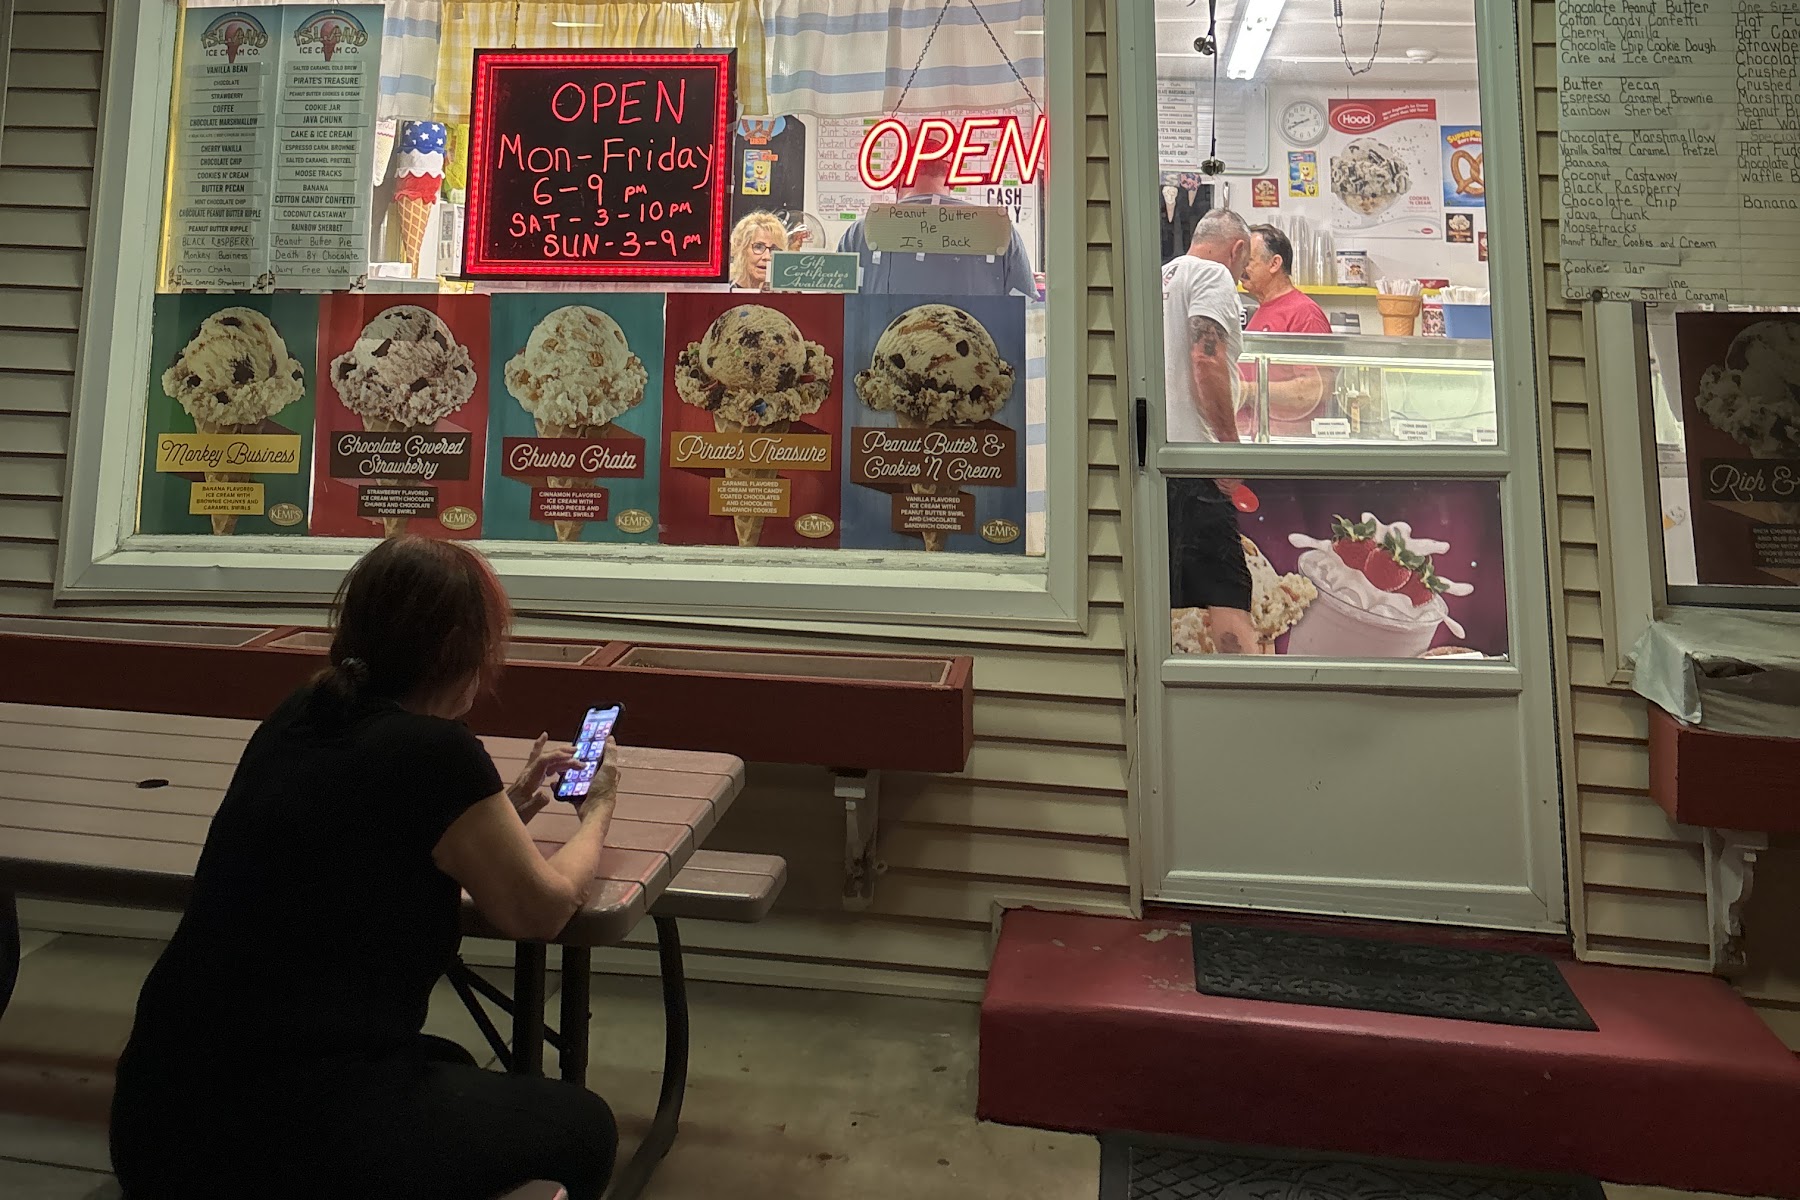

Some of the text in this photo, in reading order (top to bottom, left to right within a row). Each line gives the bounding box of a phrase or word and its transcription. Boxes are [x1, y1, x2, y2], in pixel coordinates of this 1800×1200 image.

[1559, 0, 1709, 13] Chocolate Peanut Butter
[1559, 12, 1698, 26] Cotton Candy Confetti
[1736, 12, 1764, 27] Hot
[200, 27, 268, 49] ISLAND
[293, 25, 368, 47] ISLAND
[1561, 25, 1659, 39] Cherry Vanilla
[1735, 25, 1761, 39] Hot
[1560, 38, 1717, 54] Chocolate Chip Cookie Dough
[1737, 39, 1800, 52] Strawbe
[1561, 52, 1590, 64] Cake
[1622, 52, 1648, 64] Ice
[1653, 52, 1692, 64] Cream
[206, 65, 248, 74] VANILLA BEAN
[293, 77, 358, 85] PIRATE'S TREASURE
[1563, 77, 1660, 91] Butter Pecan
[552, 79, 685, 124] OPEN
[1560, 91, 1610, 103] Espresso
[1671, 89, 1713, 103] Brownie
[212, 105, 234, 113] COFFEE
[1562, 103, 1673, 117] Rainbow Sherbet
[303, 115, 317, 123] JAVA
[1342, 114, 1371, 124] Hood
[291, 130, 308, 138] CAKE
[316, 130, 328, 138] ICE
[329, 130, 352, 138] CREAM
[1560, 129, 1715, 143] Chocolate Marshmallow
[859, 115, 1047, 190] OPEN
[1565, 155, 1610, 168] Banana
[1738, 155, 1788, 169] Chocolate
[1562, 167, 1678, 181] Coconut Castaway
[225, 184, 245, 192] PECAN
[1564, 180, 1681, 197] Black Raspberry
[275, 195, 355, 204] COTTON CANDY CONFETTI
[987, 188, 1022, 205] CASH
[1562, 193, 1677, 211] Chocolate Chip
[1743, 195, 1798, 209] Banana
[890, 206, 978, 222] Peanut Butter
[1565, 206, 1650, 220] Java Chunk
[920, 221, 937, 234] Pie
[182, 237, 254, 247] BLACK RASPBERRY
[900, 236, 971, 248] Is Back
[183, 250, 248, 259] Monkey Business
[275, 250, 298, 259] Death
[322, 250, 359, 260] Chocolate
[800, 256, 826, 269] Gift
[784, 266, 849, 279] Certificates
[780, 277, 844, 288] Available
[338, 434, 466, 457] Chocolate Covered
[677, 435, 826, 463] Pirate's Treasure
[861, 430, 1005, 457] Peanut Butter &
[162, 440, 295, 468] Monkey Business
[510, 444, 637, 472] Churro Chata
[359, 454, 439, 480] Strawberry
[864, 455, 921, 479] Cookies
[947, 457, 1002, 481] Cream
[1710, 464, 1766, 504] Rich
[271, 510, 300, 519] KEMPS
[442, 514, 475, 523] KEMPS
[618, 516, 650, 526] KEMPS
[798, 520, 831, 531] KEMPS
[982, 525, 1018, 536] KEMPS
